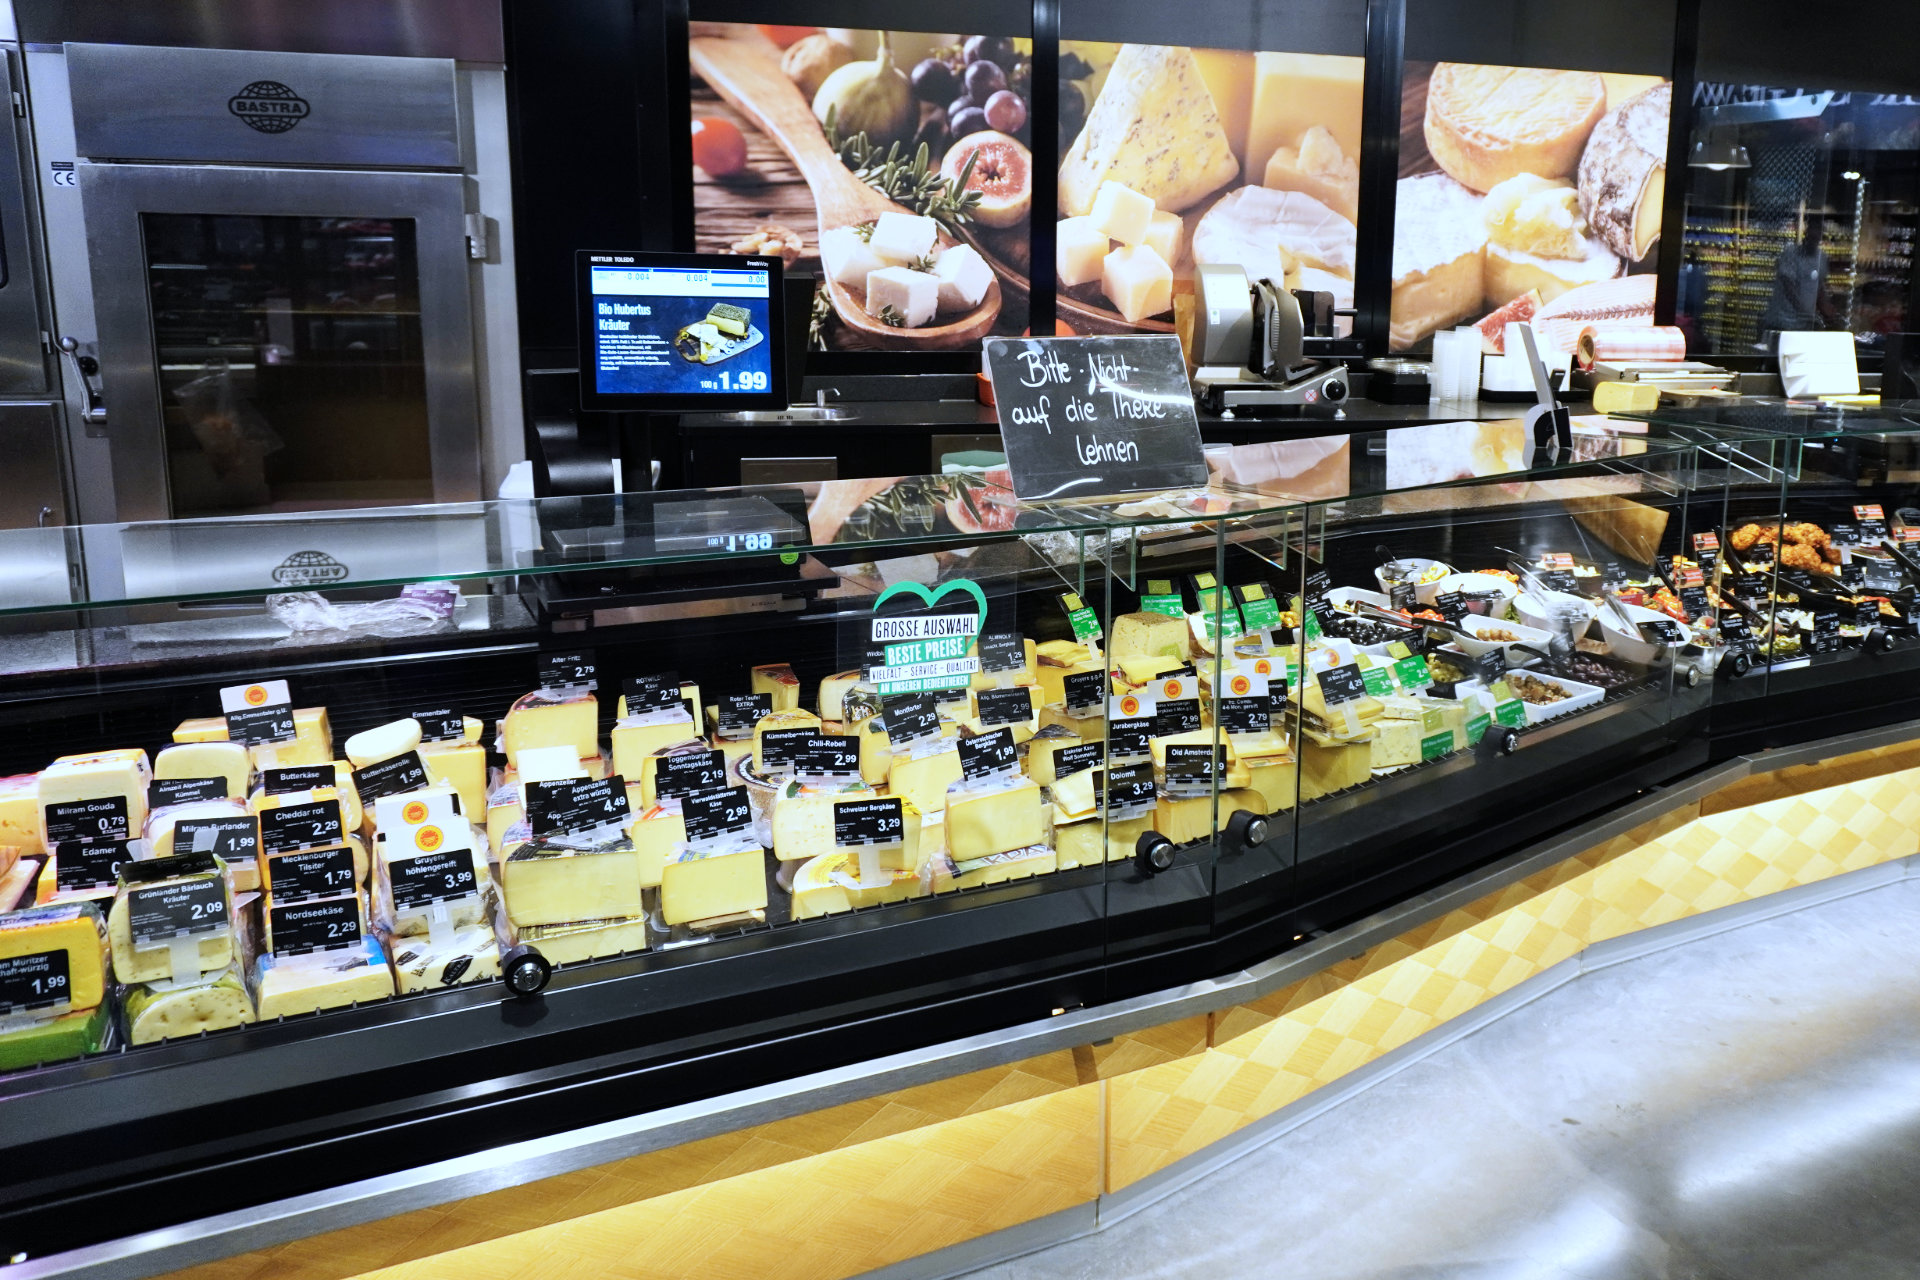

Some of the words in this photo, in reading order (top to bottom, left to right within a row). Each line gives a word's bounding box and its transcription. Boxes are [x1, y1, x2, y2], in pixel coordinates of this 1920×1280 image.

[236, 101, 303, 113] BASTRA
[598, 303, 613, 315] Bio
[614, 304, 652, 316] Hubertus
[599, 319, 631, 331] Kräuter
[1017, 350, 1072, 388] Bitte
[700, 380, 712, 388] 100
[719, 371, 767, 390] 1.99
[1012, 395, 1052, 435] auf
[1066, 395, 1098, 422] die
[1100, 387, 1167, 420] Theke
[875, 619, 919, 639] GROSSE
[923, 616, 975, 638] AUSWAHL
[887, 643, 922, 667] BESTE
[925, 637, 964, 661] PREISE
[1008, 651, 1022, 660] 1.29
[575, 665, 595, 678] 2.79
[872, 668, 902, 682] VIELFALT
[910, 664, 938, 678] SERVICE
[946, 659, 978, 674] QUALITÄT
[880, 683, 890, 694] AN
[891, 680, 922, 693] UNSEREN
[923, 675, 969, 690] BEDIENTHEKEN
[660, 688, 679, 702] 2.79
[1271, 694, 1287, 706] 3.99
[412, 708, 451, 719] Emmentaler
[1012, 703, 1030, 713] 2.99
[920, 713, 937, 727] 2.29
[1112, 720, 1150, 731] Jurabergkäse
[1181, 715, 1199, 726] 2.99
[1248, 713, 1267, 724] 2.79
[270, 720, 293, 735] 1.49
[441, 720, 462, 732] 1.79
[808, 739, 847, 748] Chili-Rebell
[995, 745, 1014, 761] 1.99
[1171, 748, 1183, 757] Old
[1184, 748, 1214, 757] Amsterda
[834, 754, 858, 766] 2.99
[1203, 762, 1224, 774] 2.9
[280, 770, 320, 781] Butterkäse
[400, 768, 422, 785] 1.99
[700, 769, 724, 784] 2.19
[1110, 770, 1136, 781] Dolomit
[539, 778, 577, 788] Appenzeller
[571, 779, 609, 794] Appenzeller
[1132, 781, 1154, 796] 3.29
[175, 789, 201, 799] Kümmel
[573, 793, 590, 803] extra
[590, 786, 612, 800] würzig
[57, 806, 86, 817] Milram
[87, 802, 116, 813] Gouda
[603, 795, 626, 812] 4.49
[839, 804, 869, 814] Schweizer
[869, 802, 896, 813] Bergkäse
[276, 808, 312, 822] Cheddar
[313, 806, 325, 816] rot
[725, 806, 748, 822] 2.99
[98, 816, 127, 831] 0.79
[312, 820, 339, 836] 2.29
[877, 818, 901, 832] 3.29
[227, 837, 255, 852] 1.99
[82, 847, 117, 858] Edamer
[281, 849, 340, 863] Mecklenburger
[298, 861, 326, 872] Tilsiter
[405, 860, 458, 876] höhlengereift
[325, 869, 352, 887] 1.79
[444, 870, 473, 890] 3.99
[138, 886, 181, 901] Grünländer
[181, 882, 215, 893] Bärlauch
[163, 893, 191, 905] Kräuter
[190, 901, 224, 920] 2.09
[285, 905, 345, 921] Nordseekäse
[327, 921, 357, 939] 2.29
[13, 956, 49, 968] Müritzer
[32, 975, 67, 995] 1.99
